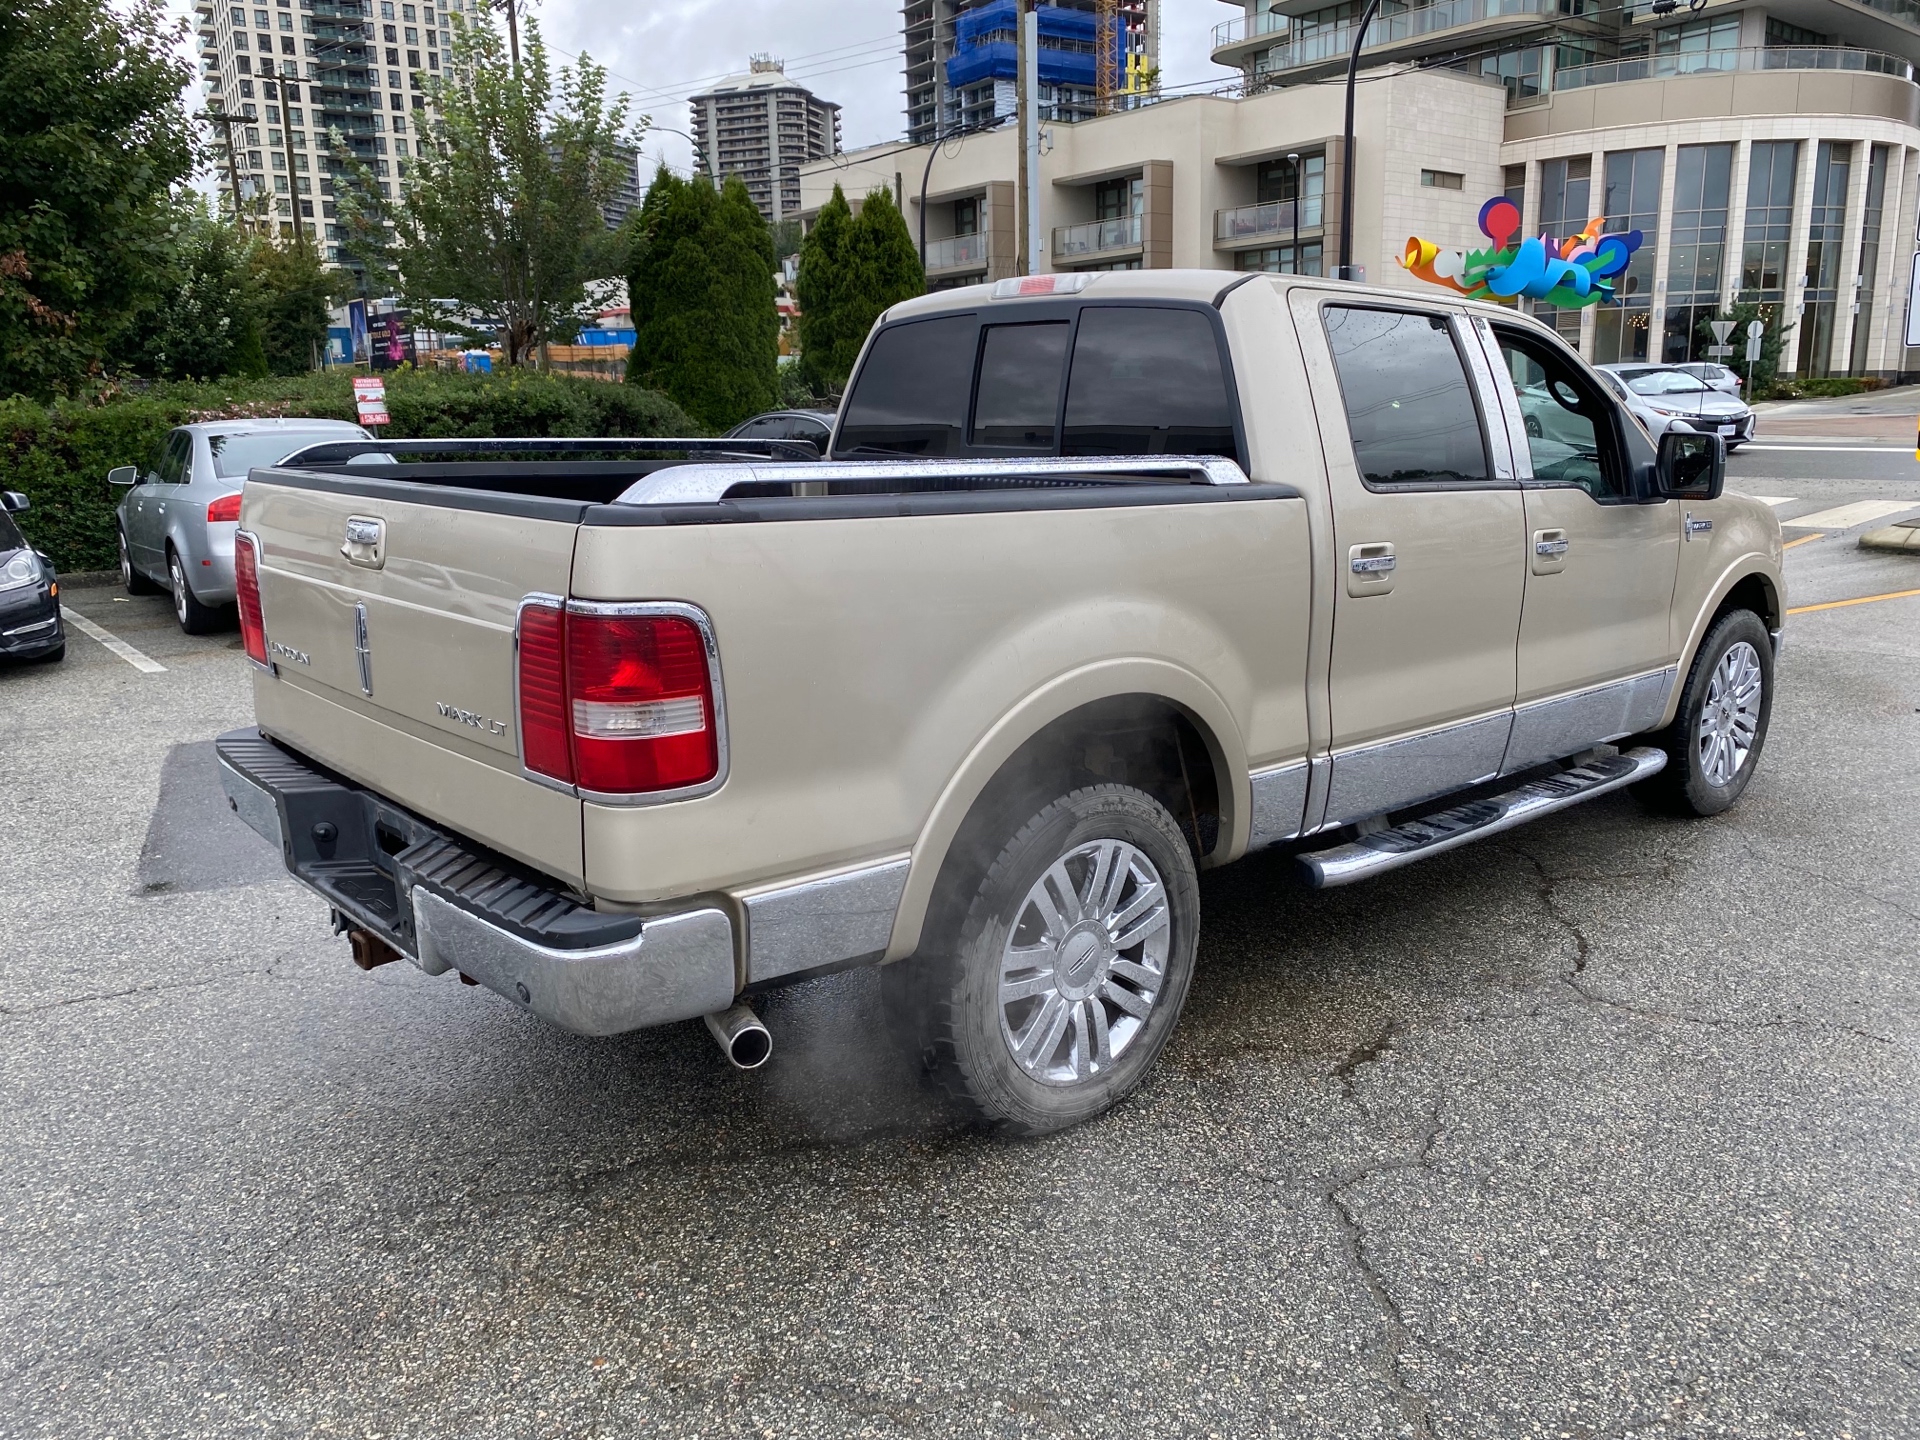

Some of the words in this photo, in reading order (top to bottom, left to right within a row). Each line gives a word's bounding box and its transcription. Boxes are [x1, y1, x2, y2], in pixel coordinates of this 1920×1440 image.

[270, 640, 311, 666] LINCOLN
[436, 701, 484, 730] MARK
[487, 718, 507, 737] LT
